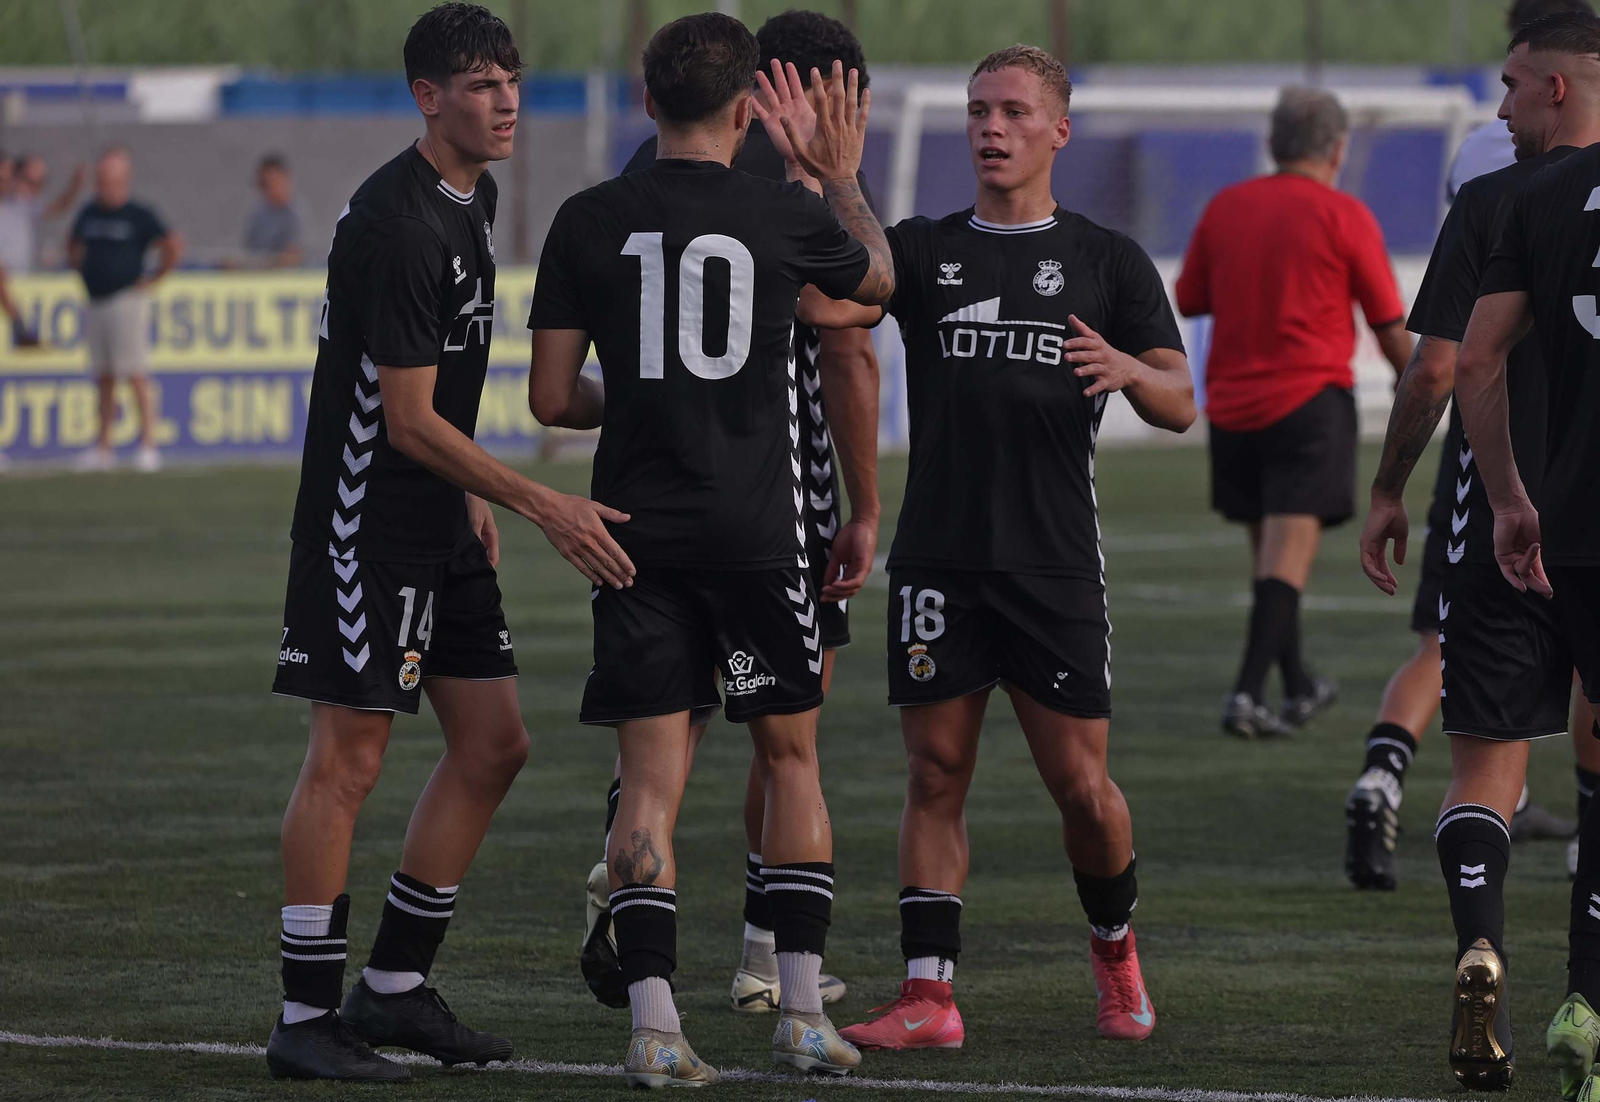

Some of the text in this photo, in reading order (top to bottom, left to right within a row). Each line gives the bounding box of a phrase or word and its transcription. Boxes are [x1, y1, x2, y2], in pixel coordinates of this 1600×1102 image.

[621, 231, 755, 381] 10
[938, 328, 1064, 366] LOTUS
[188, 376, 293, 446] SIN
[397, 586, 434, 651] 14
[899, 586, 946, 643] 18
[736, 672, 776, 691] Galán
